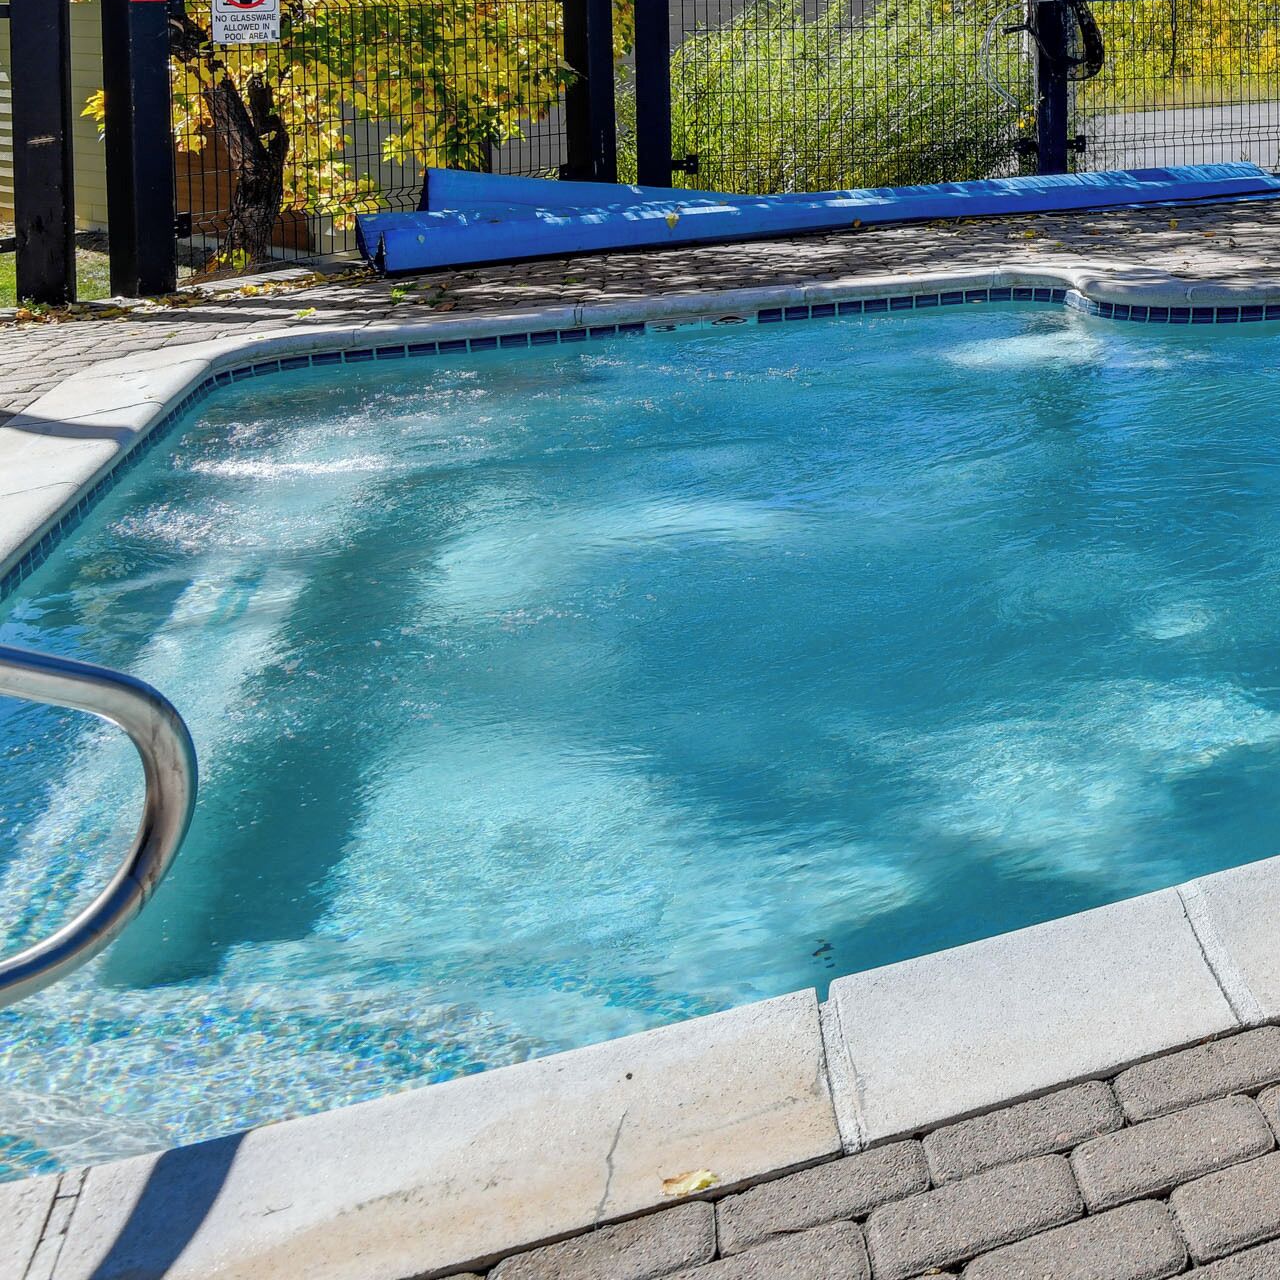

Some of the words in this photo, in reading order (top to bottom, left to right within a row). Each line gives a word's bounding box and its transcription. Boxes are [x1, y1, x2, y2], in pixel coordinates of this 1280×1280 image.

[230, 14, 276, 22] GLASSWARE
[223, 23, 260, 31] ALLOWED
[224, 32, 246, 40] POOL
[249, 31, 269, 40] AREA
